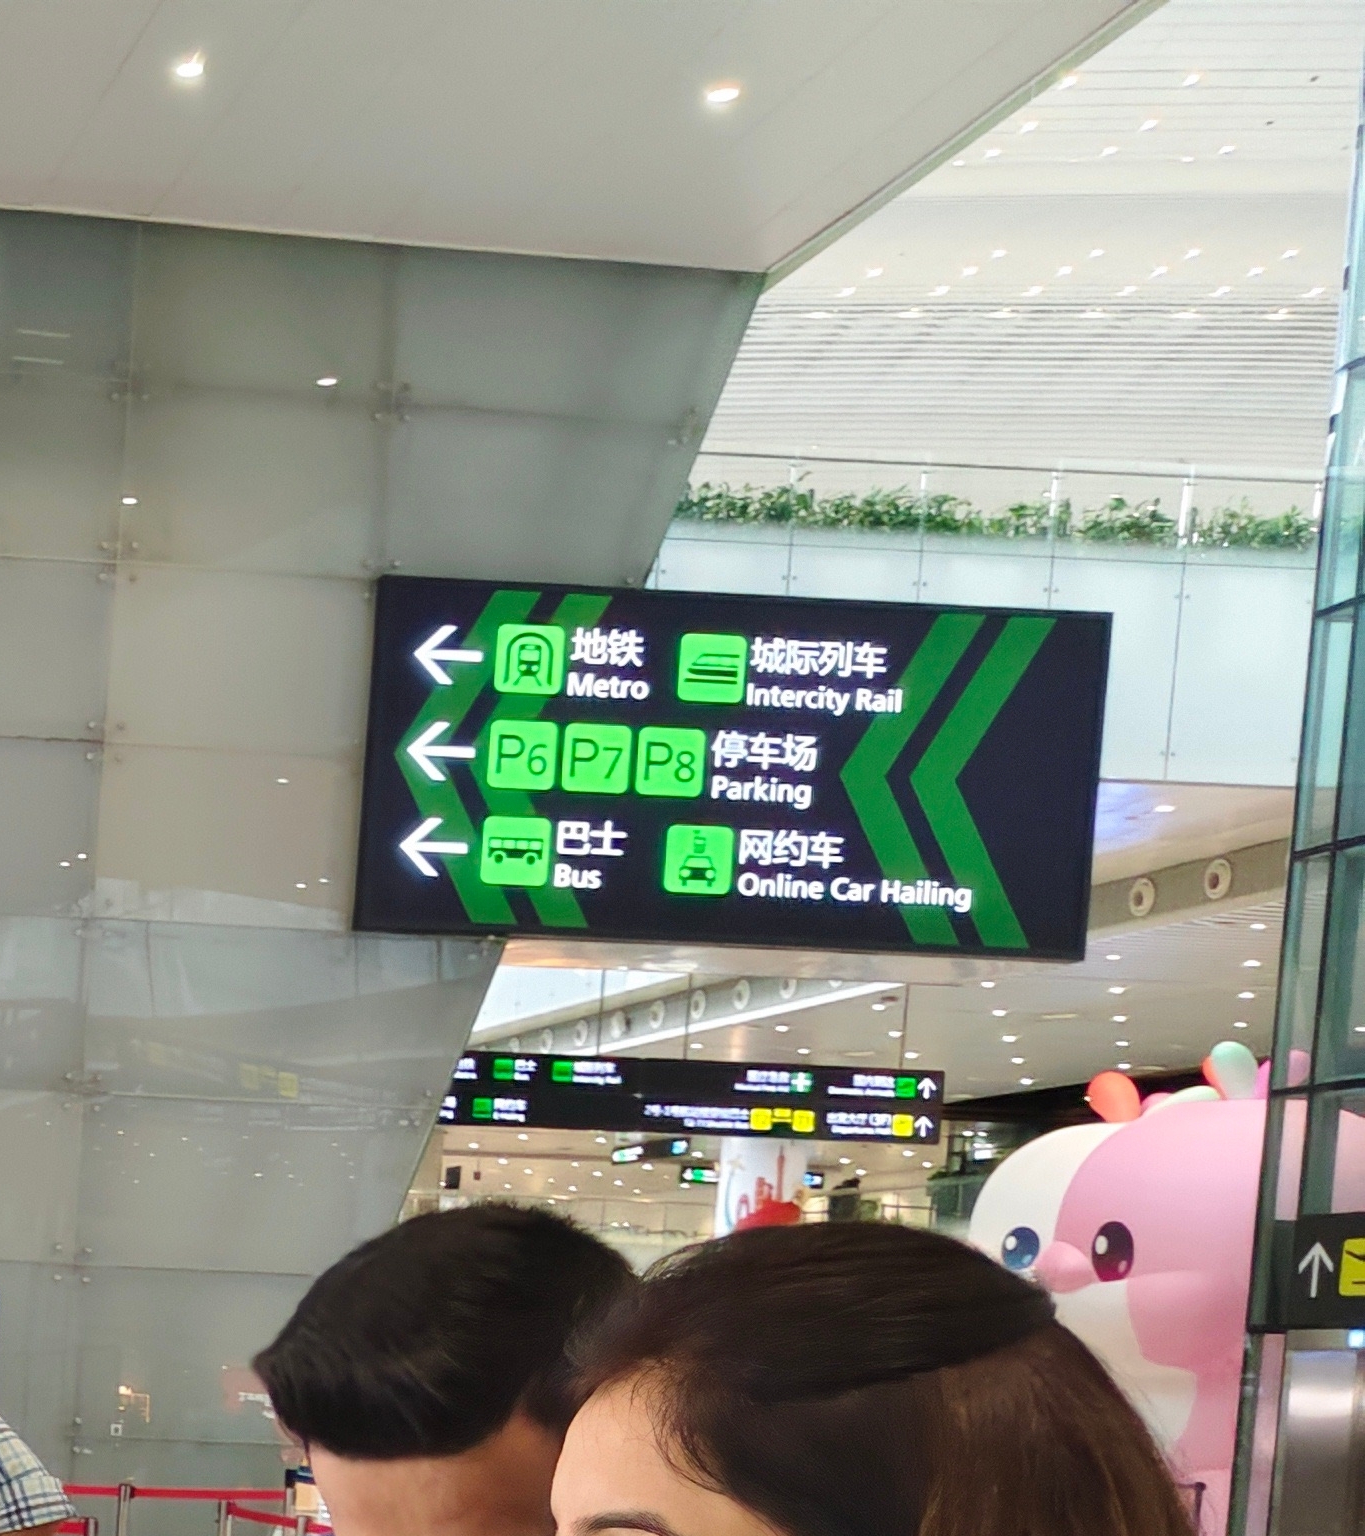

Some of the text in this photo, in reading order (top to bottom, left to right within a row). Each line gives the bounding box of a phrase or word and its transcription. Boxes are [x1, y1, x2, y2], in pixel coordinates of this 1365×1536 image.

[569, 627, 645, 667] 地铁
[750, 637, 888, 679] 城际列车
[566, 672, 650, 701] Metro
[746, 683, 903, 717] Intercity Rail
[495, 734, 697, 783] P6 P7 P8
[710, 730, 818, 772] 停车场
[710, 775, 813, 810] Parking
[556, 819, 628, 858] 巴士
[738, 829, 845, 869] 网约车
[553, 864, 602, 890] Bus
[737, 872, 974, 913] Online Car Hailing
